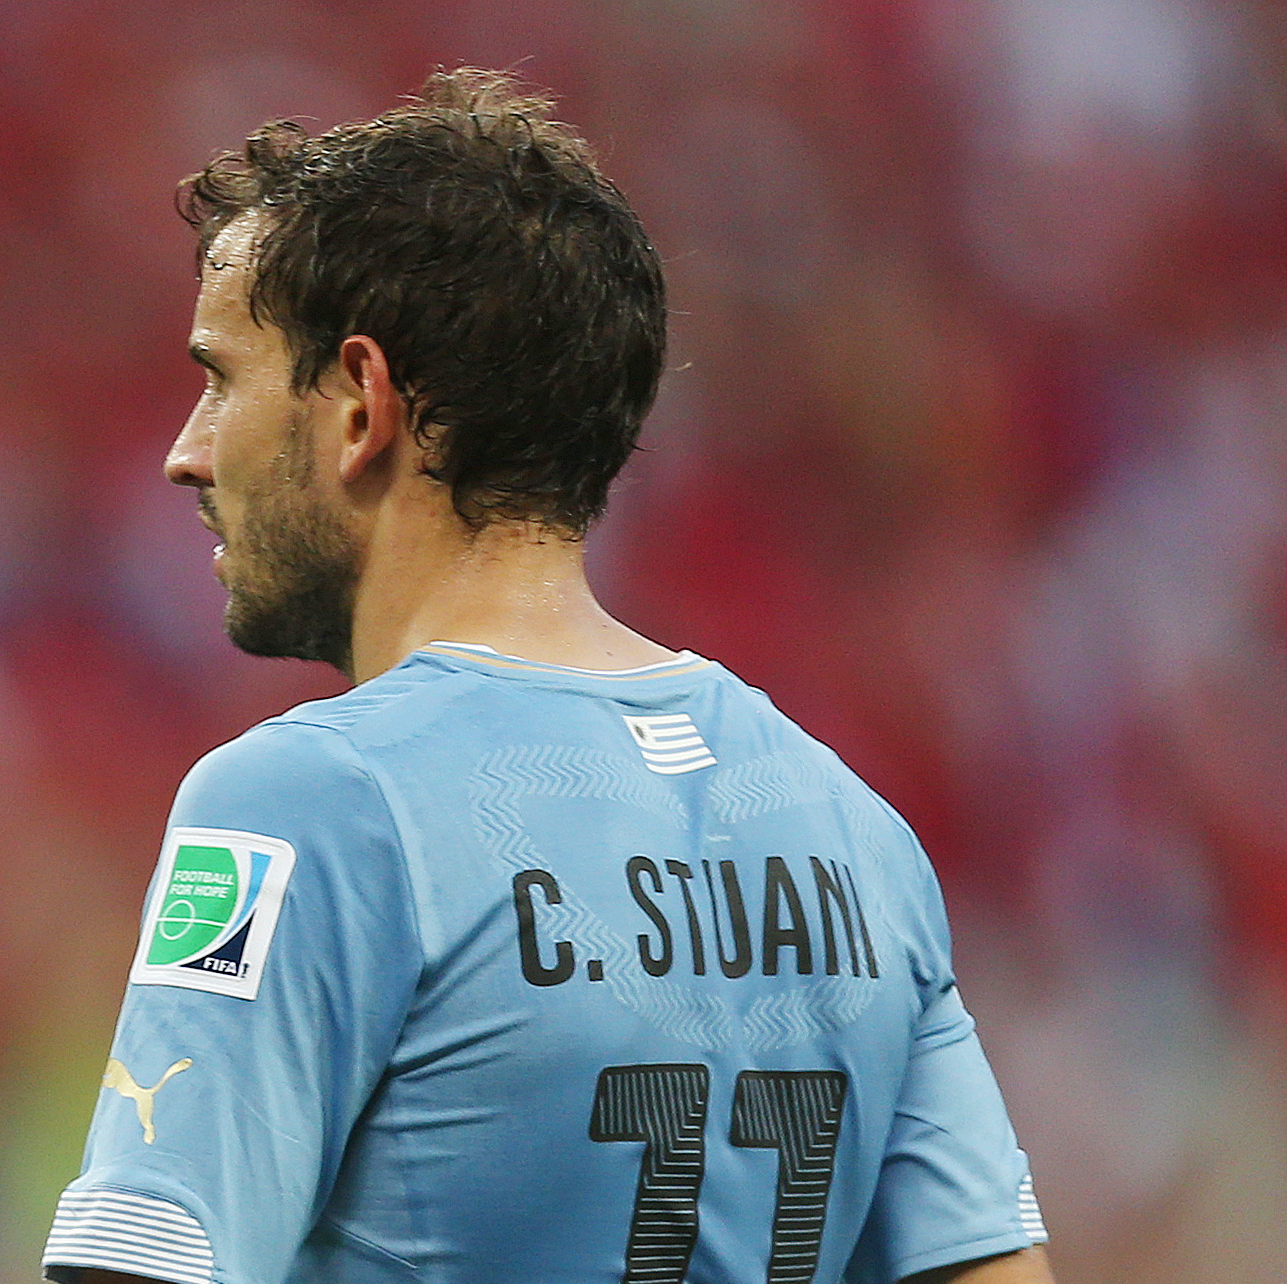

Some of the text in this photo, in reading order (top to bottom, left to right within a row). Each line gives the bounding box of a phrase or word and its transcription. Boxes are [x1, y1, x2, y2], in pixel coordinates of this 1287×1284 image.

[173, 870, 234, 885] FOOTBALL
[169, 884, 229, 898] FOR HOPE
[512, 855, 880, 988] C. STUANI
[203, 957, 238, 974] FIFA
